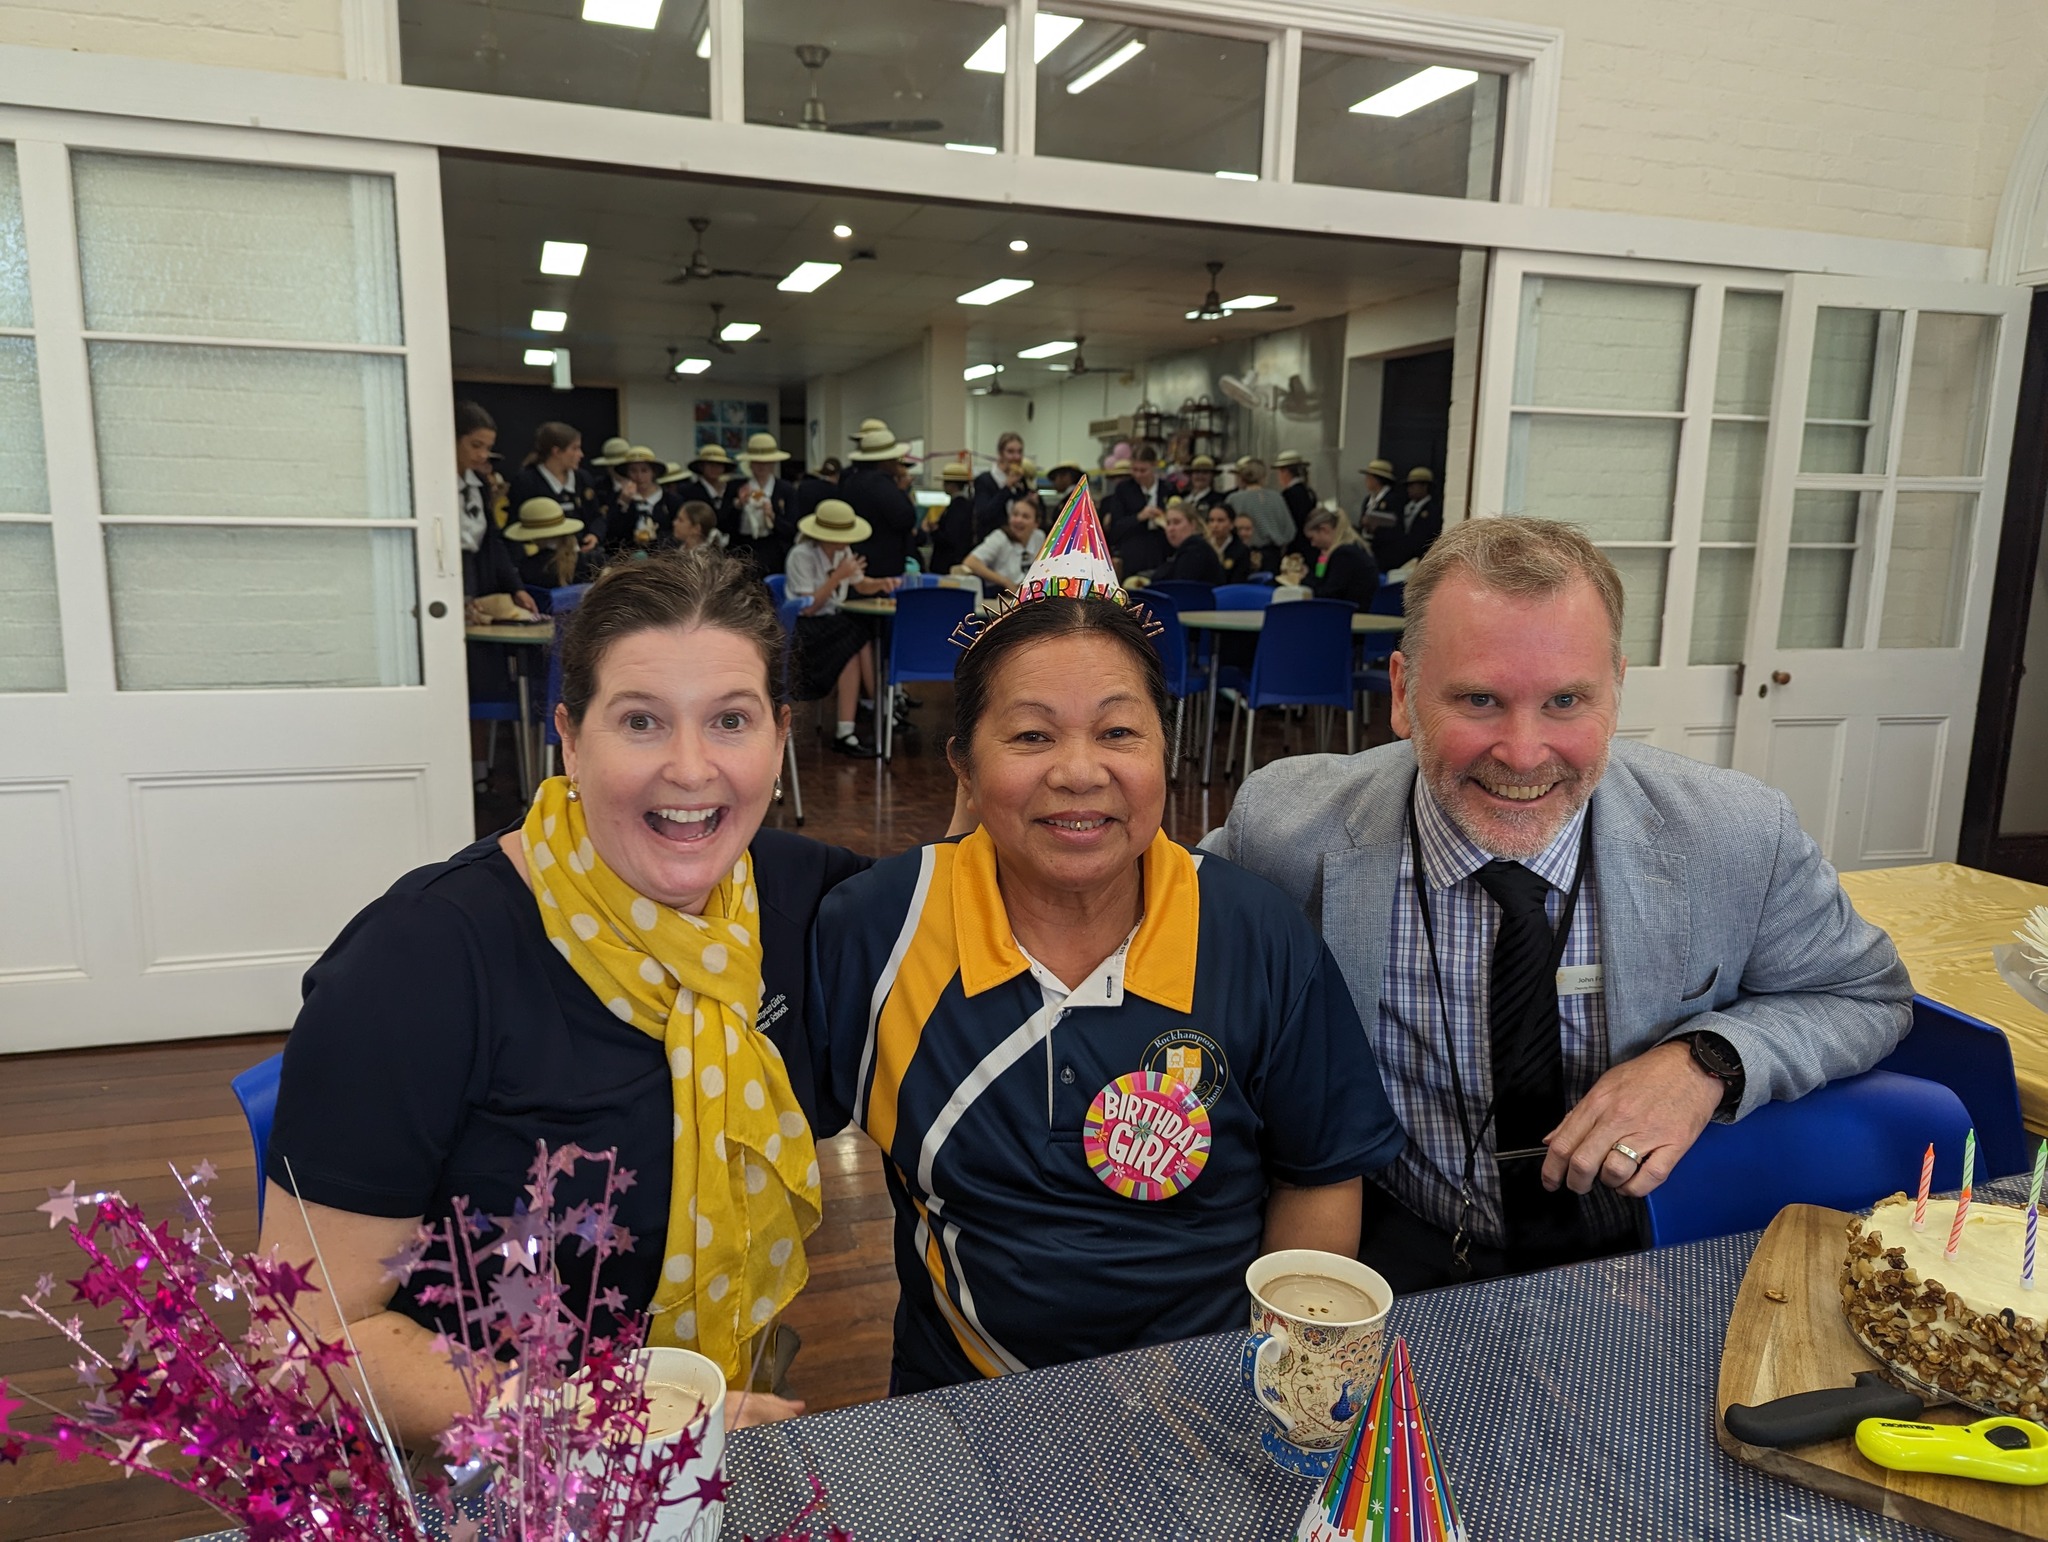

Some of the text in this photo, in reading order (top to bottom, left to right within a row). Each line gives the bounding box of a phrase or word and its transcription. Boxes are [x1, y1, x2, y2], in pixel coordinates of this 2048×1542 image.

[770, 993, 786, 1008] Girls
[770, 1003, 789, 1023] School
[1154, 1029, 1216, 1051] Rockhampton
[1102, 1091, 1210, 1158] BIRTHDAY
[1108, 1121, 1178, 1185] GIRL
